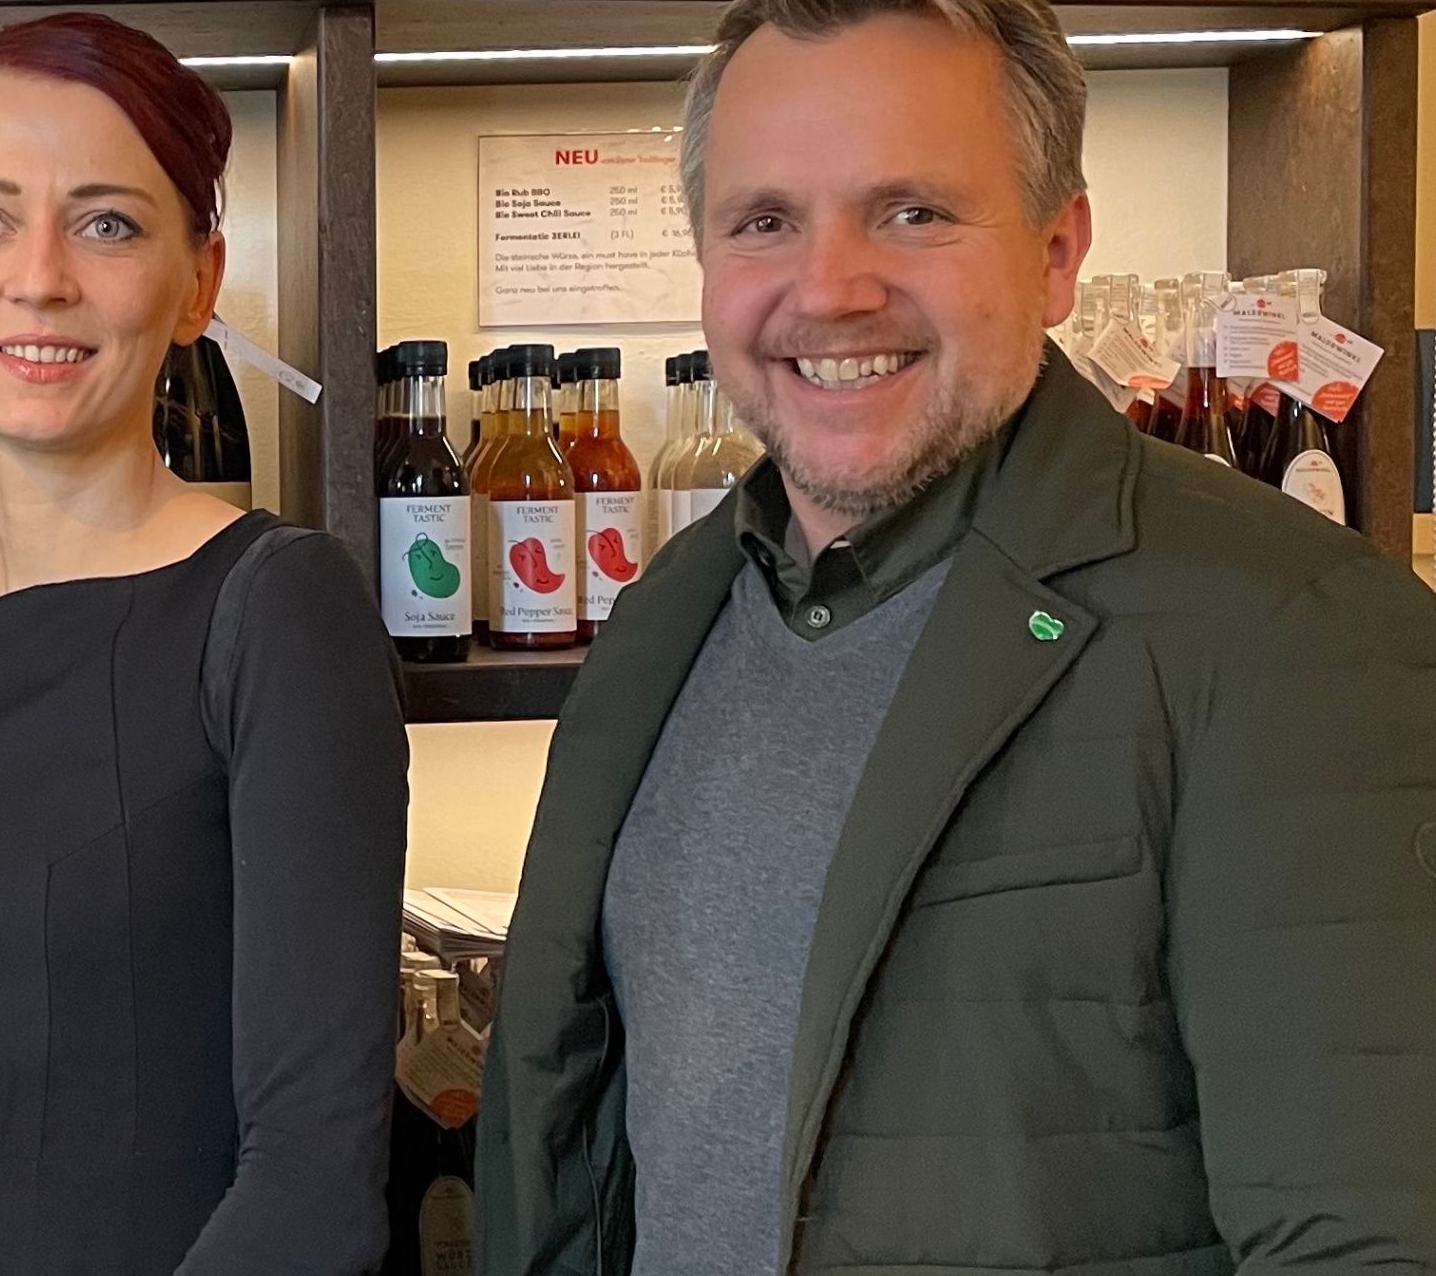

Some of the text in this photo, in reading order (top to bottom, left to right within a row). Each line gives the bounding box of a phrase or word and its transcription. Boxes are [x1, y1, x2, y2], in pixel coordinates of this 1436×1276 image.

[555, 150, 599, 165] NEU
[495, 189, 510, 197] Bio
[531, 188, 551, 197] BBQ
[627, 186, 638, 194] ml
[495, 200, 510, 208] Bio
[512, 200, 531, 209] Soja
[533, 199, 561, 207] Sauce
[609, 197, 625, 205] 250
[627, 197, 638, 205] ml
[495, 210, 510, 218] Bio
[512, 210, 539, 218] Sweet
[563, 209, 591, 217] Sauce
[609, 208, 625, 216] 250
[627, 208, 638, 216] ml
[596, 497, 633, 506] FERMENT
[406, 504, 452, 513] FERMENT
[516, 506, 558, 515] FERMENT
[602, 506, 630, 514] TASTIC
[413, 514, 445, 522] TASTIC
[524, 515, 554, 523] TASTIC
[404, 611, 455, 623] Soja Sauce
[518, 607, 551, 619] Pepper
